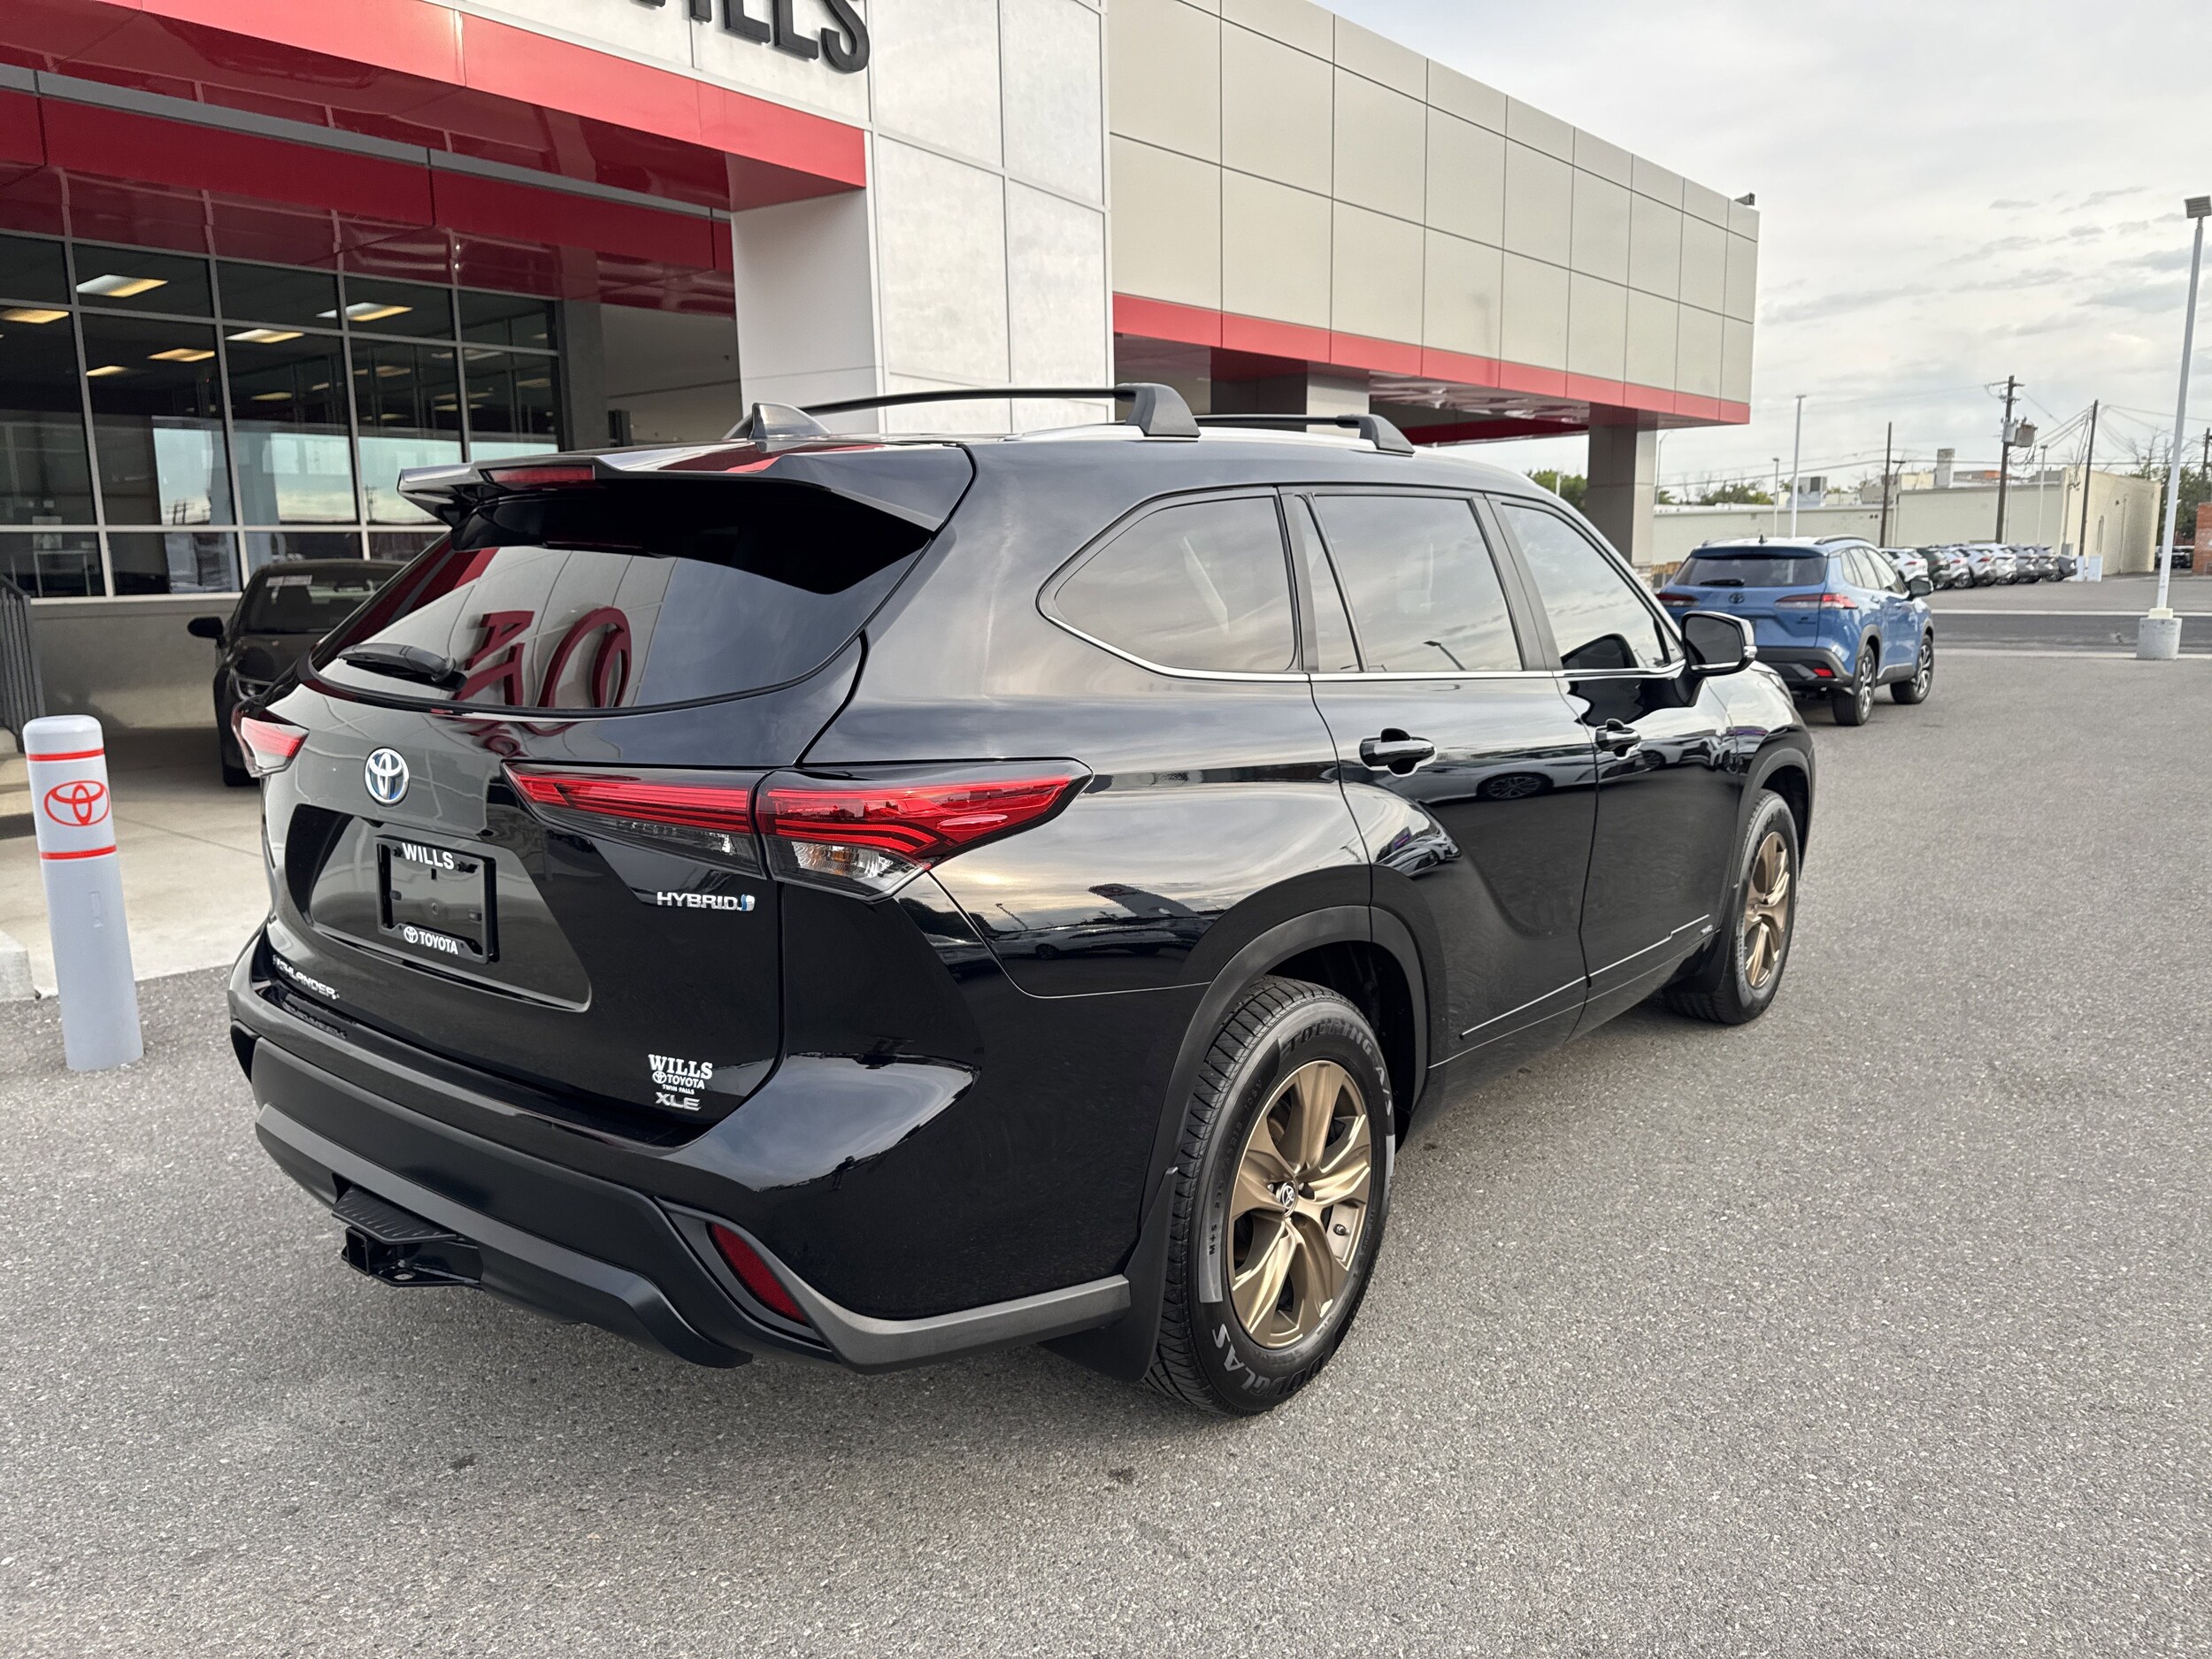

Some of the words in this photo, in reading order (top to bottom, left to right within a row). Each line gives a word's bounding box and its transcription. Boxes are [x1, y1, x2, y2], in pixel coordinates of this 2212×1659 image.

[402, 842, 455, 870] WILLS
[657, 892, 738, 911] HYBRID
[419, 930, 458, 956] TOYOTA
[1280, 1018, 1373, 1056] TOURING
[648, 1053, 713, 1080] WILLS
[667, 1073, 705, 1090] TOYOTA
[679, 1087, 695, 1095] FALLS
[655, 1091, 702, 1111] XLE
[1208, 1224, 1217, 1256] M+S
[1212, 1324, 1325, 1397] DOUGLAS
